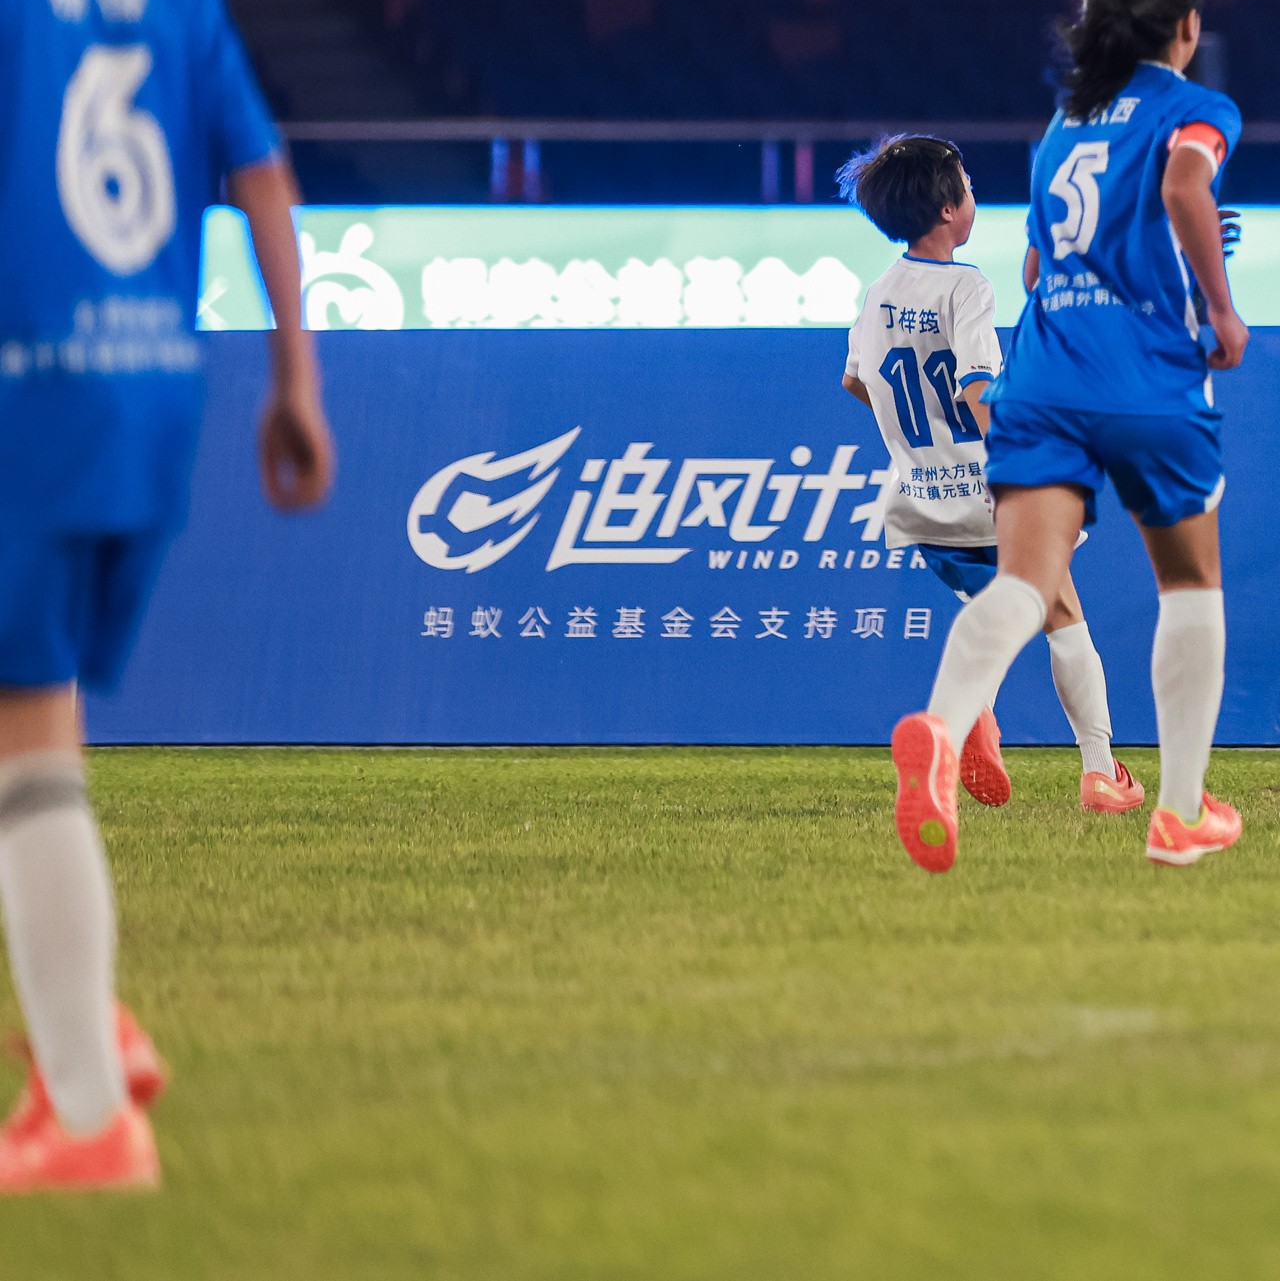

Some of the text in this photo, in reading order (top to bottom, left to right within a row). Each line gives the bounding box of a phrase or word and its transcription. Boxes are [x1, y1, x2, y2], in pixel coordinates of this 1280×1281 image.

[56, 43, 177, 275] 6
[1048, 141, 1109, 260] 5
[911, 462, 982, 482] 贵州大方县
[708, 549, 799, 570] WIND
[420, 606, 933, 639] 蚂蚁公益基金会支持项目
